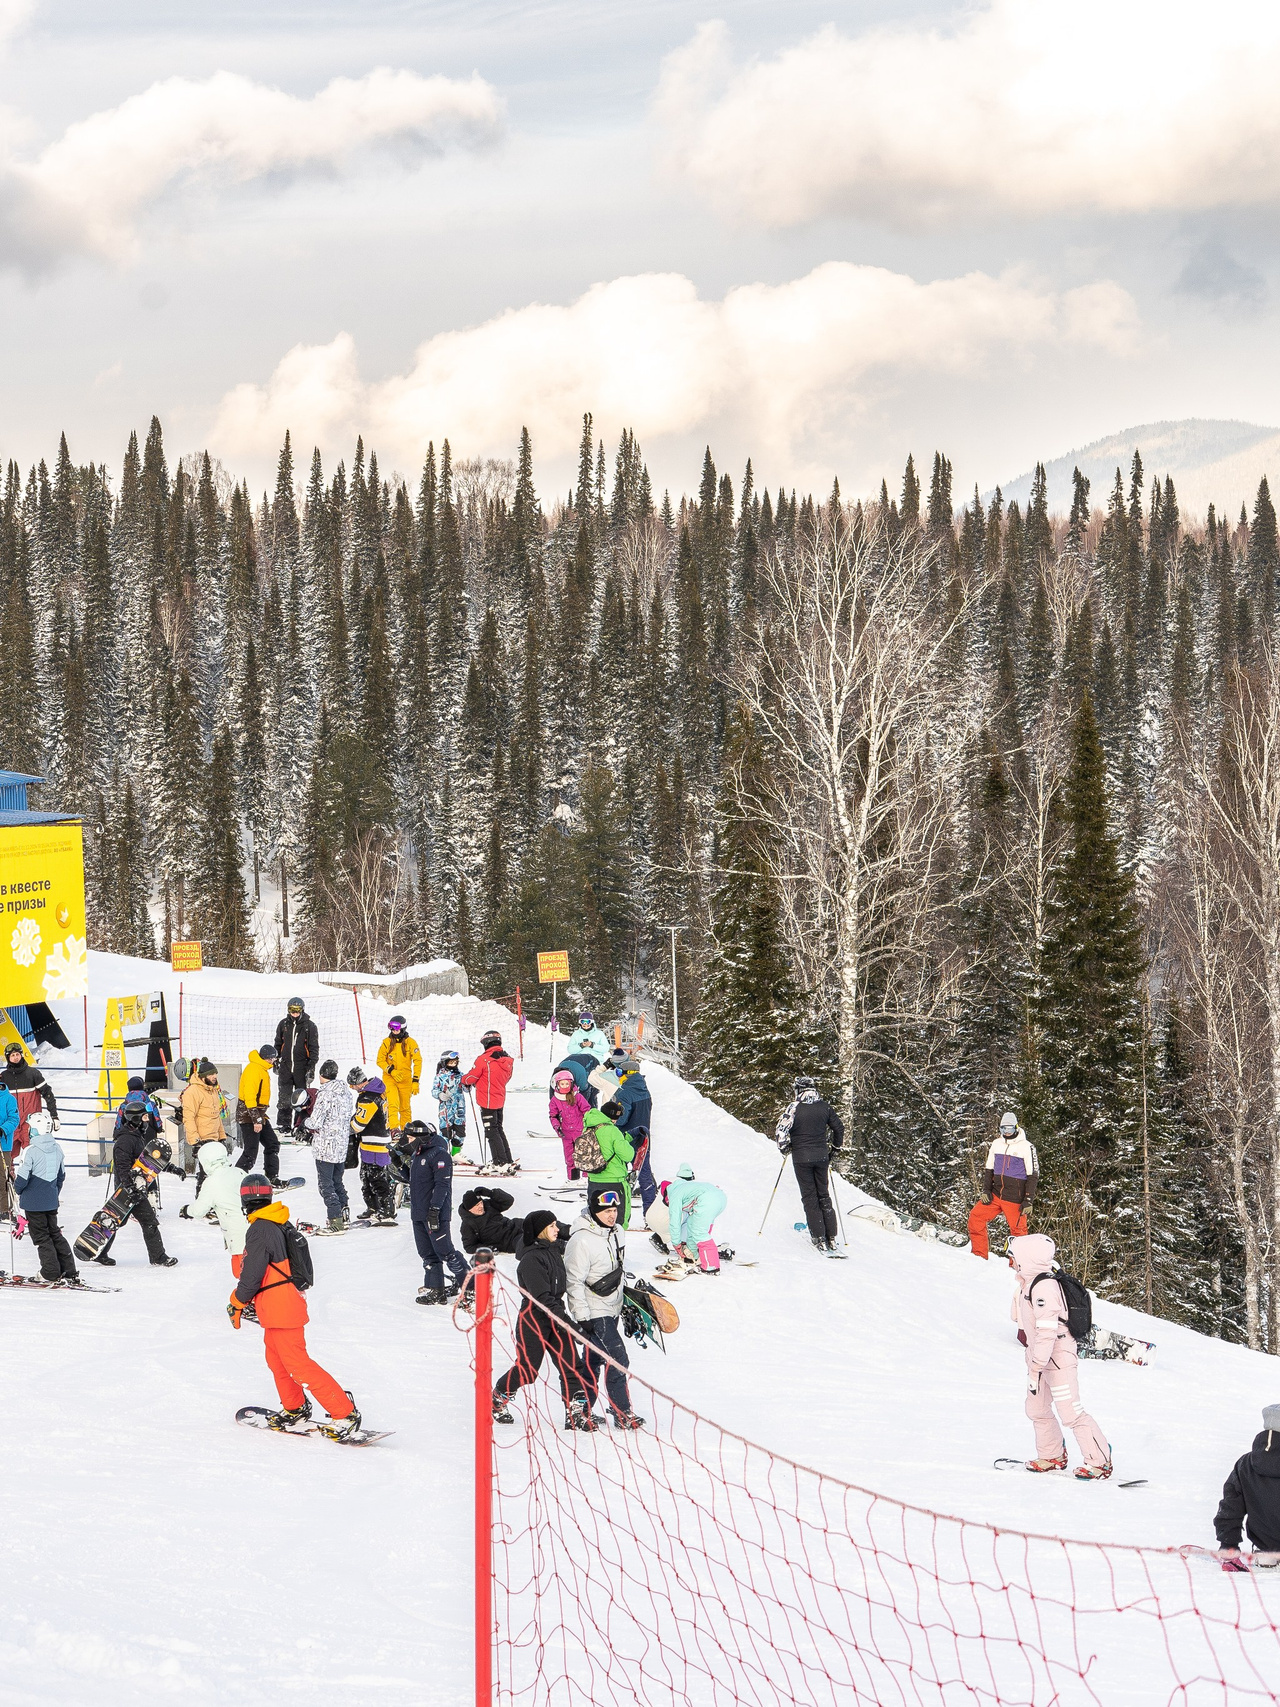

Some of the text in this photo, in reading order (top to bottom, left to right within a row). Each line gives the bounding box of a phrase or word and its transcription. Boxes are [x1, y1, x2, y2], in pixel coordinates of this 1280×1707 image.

[0, 885, 7, 895] в
[10, 880, 51, 894] квесте
[7, 898, 46, 914] призы
[173, 959, 201, 970] ЗАПРЕЩЕН
[541, 961, 567, 969] ПРОХОД
[540, 969, 569, 980] ЗАПРЕЩЕН
[356, 1106, 367, 1119] 71
